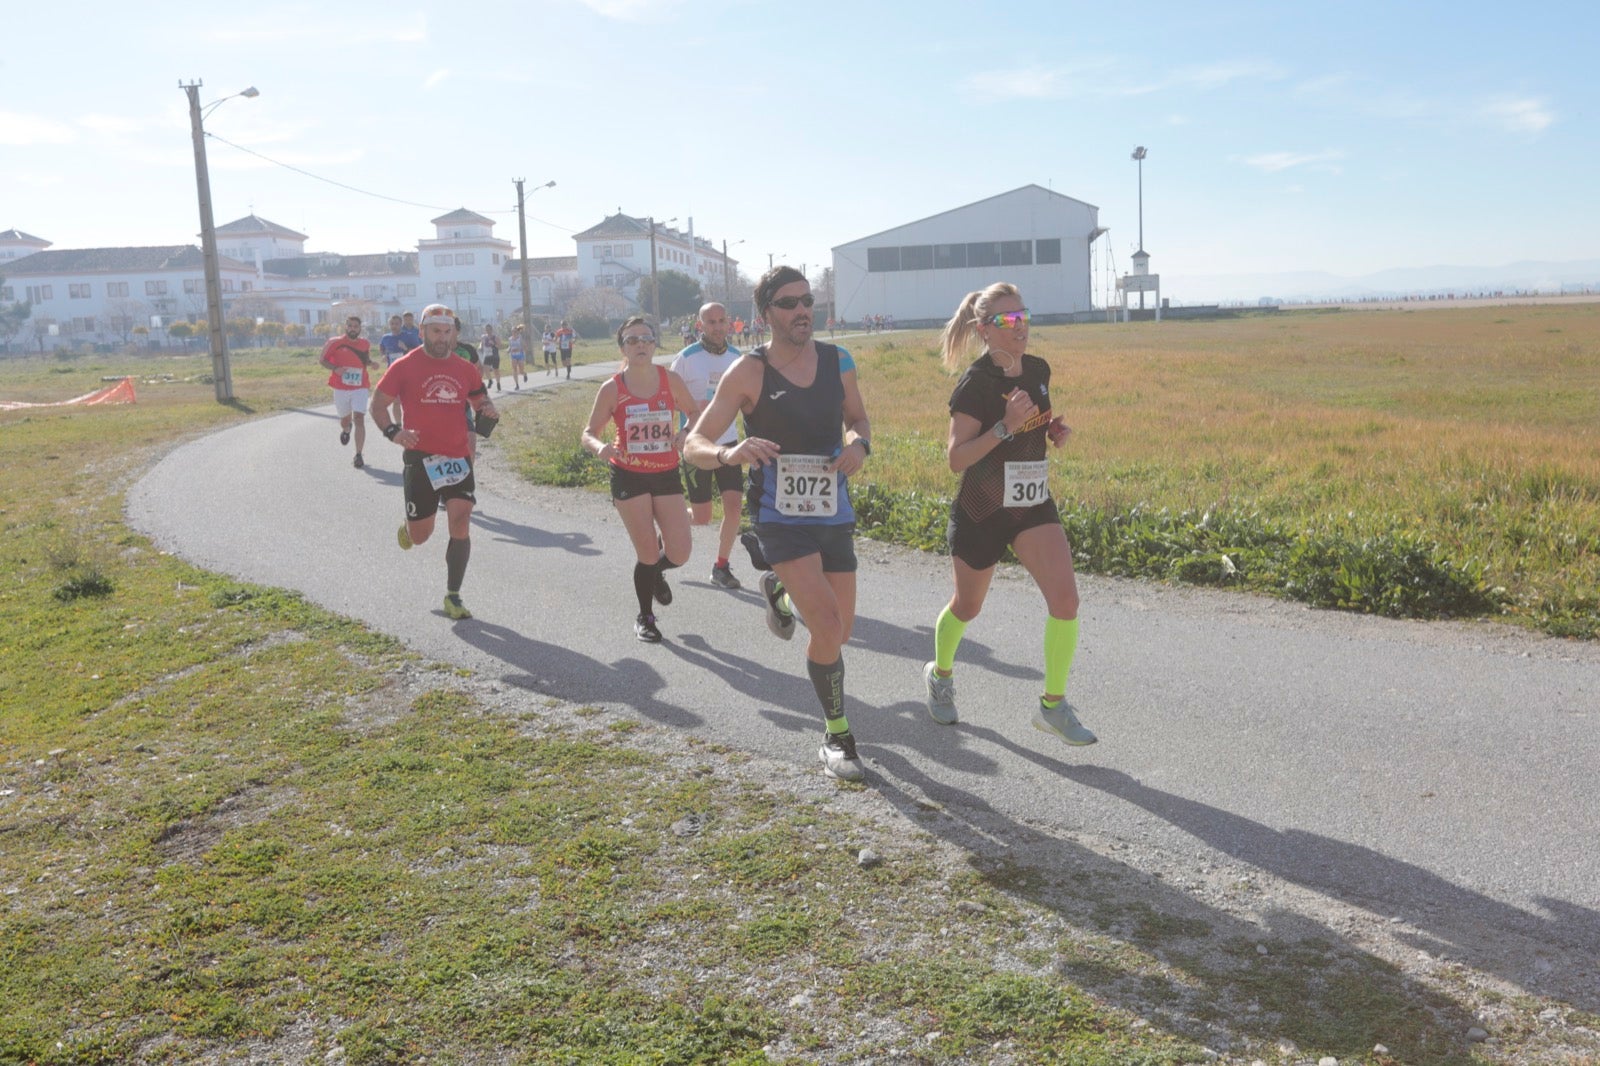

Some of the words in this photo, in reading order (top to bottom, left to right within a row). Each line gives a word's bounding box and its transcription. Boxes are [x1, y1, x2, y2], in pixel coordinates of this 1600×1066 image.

[630, 423, 671, 441] 2184
[435, 462, 462, 476] 120
[784, 476, 831, 496] 3072
[1012, 480, 1048, 502] 301
